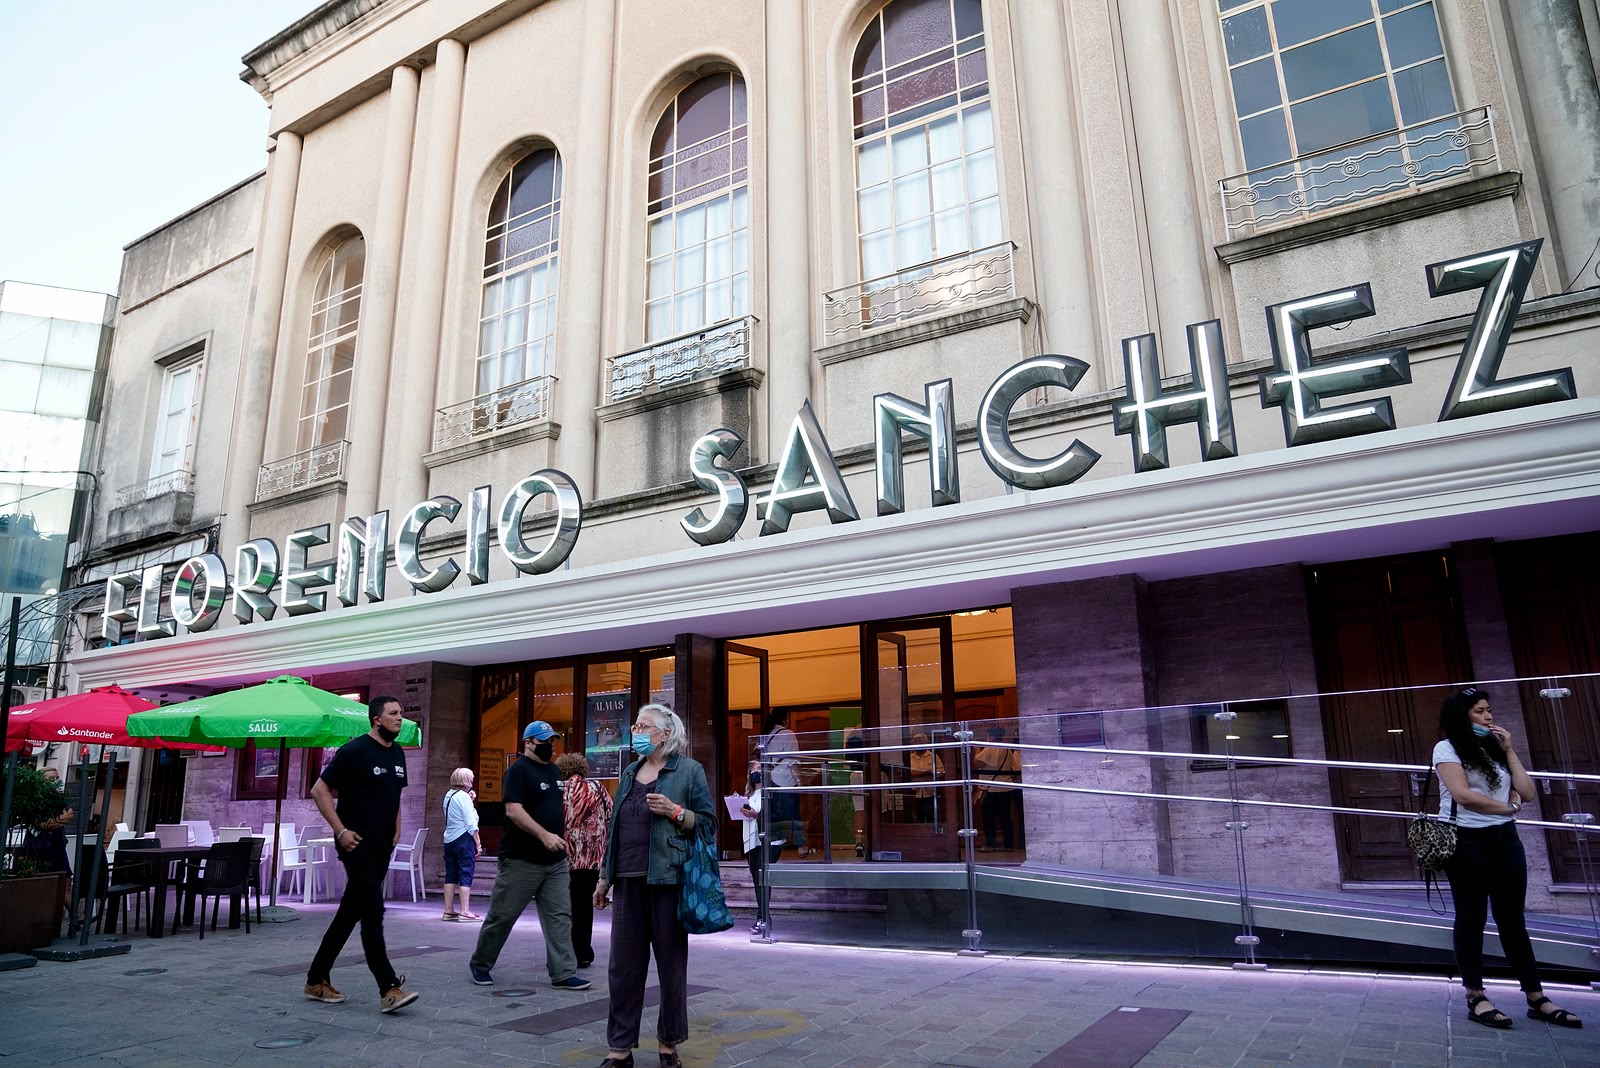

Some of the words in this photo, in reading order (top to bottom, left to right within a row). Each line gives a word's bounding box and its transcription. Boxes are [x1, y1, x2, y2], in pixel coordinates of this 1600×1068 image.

[101, 468, 583, 644] FLORENCIO
[679, 238, 1576, 546] SANCHEZ
[594, 700, 624, 711] ALMAS
[69, 727, 114, 739] Santander
[249, 723, 278, 732] SALUS
